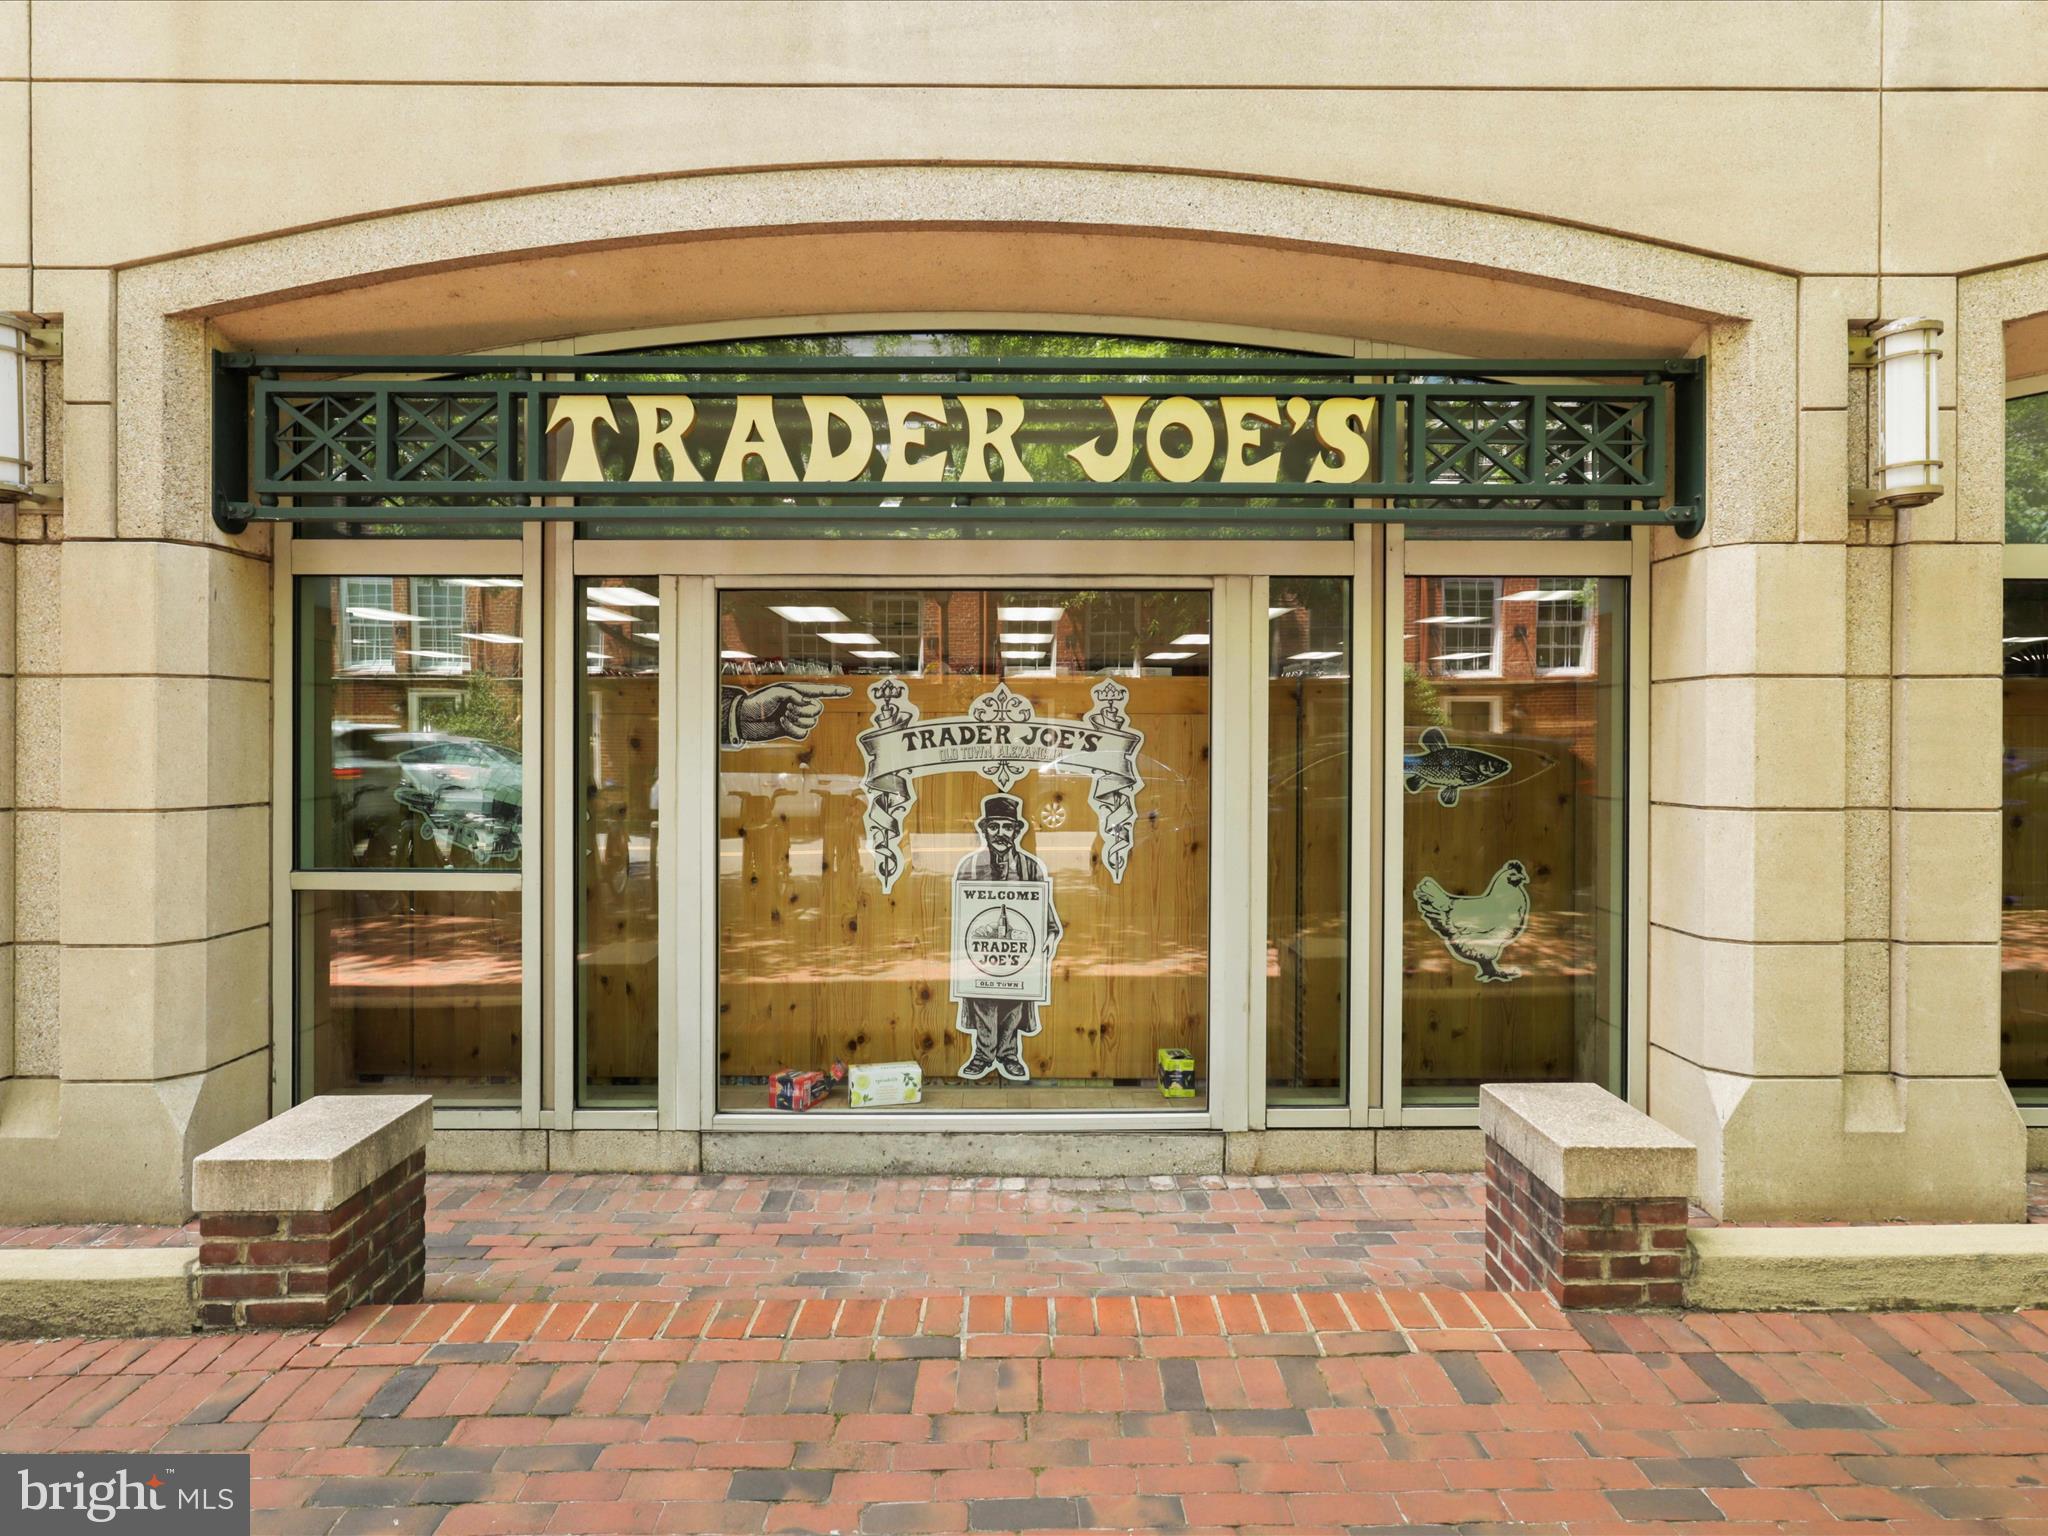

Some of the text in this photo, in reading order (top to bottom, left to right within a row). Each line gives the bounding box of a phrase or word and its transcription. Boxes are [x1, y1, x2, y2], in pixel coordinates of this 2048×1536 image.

[545, 395, 1376, 483] TRADER JOE'S
[901, 725, 1103, 752] TRADER JOE'S
[940, 748, 959, 762] OLD
[964, 890, 1040, 901] WELCOME
[972, 941, 1028, 953] TRADER
[979, 955, 1020, 966] JOE'S
